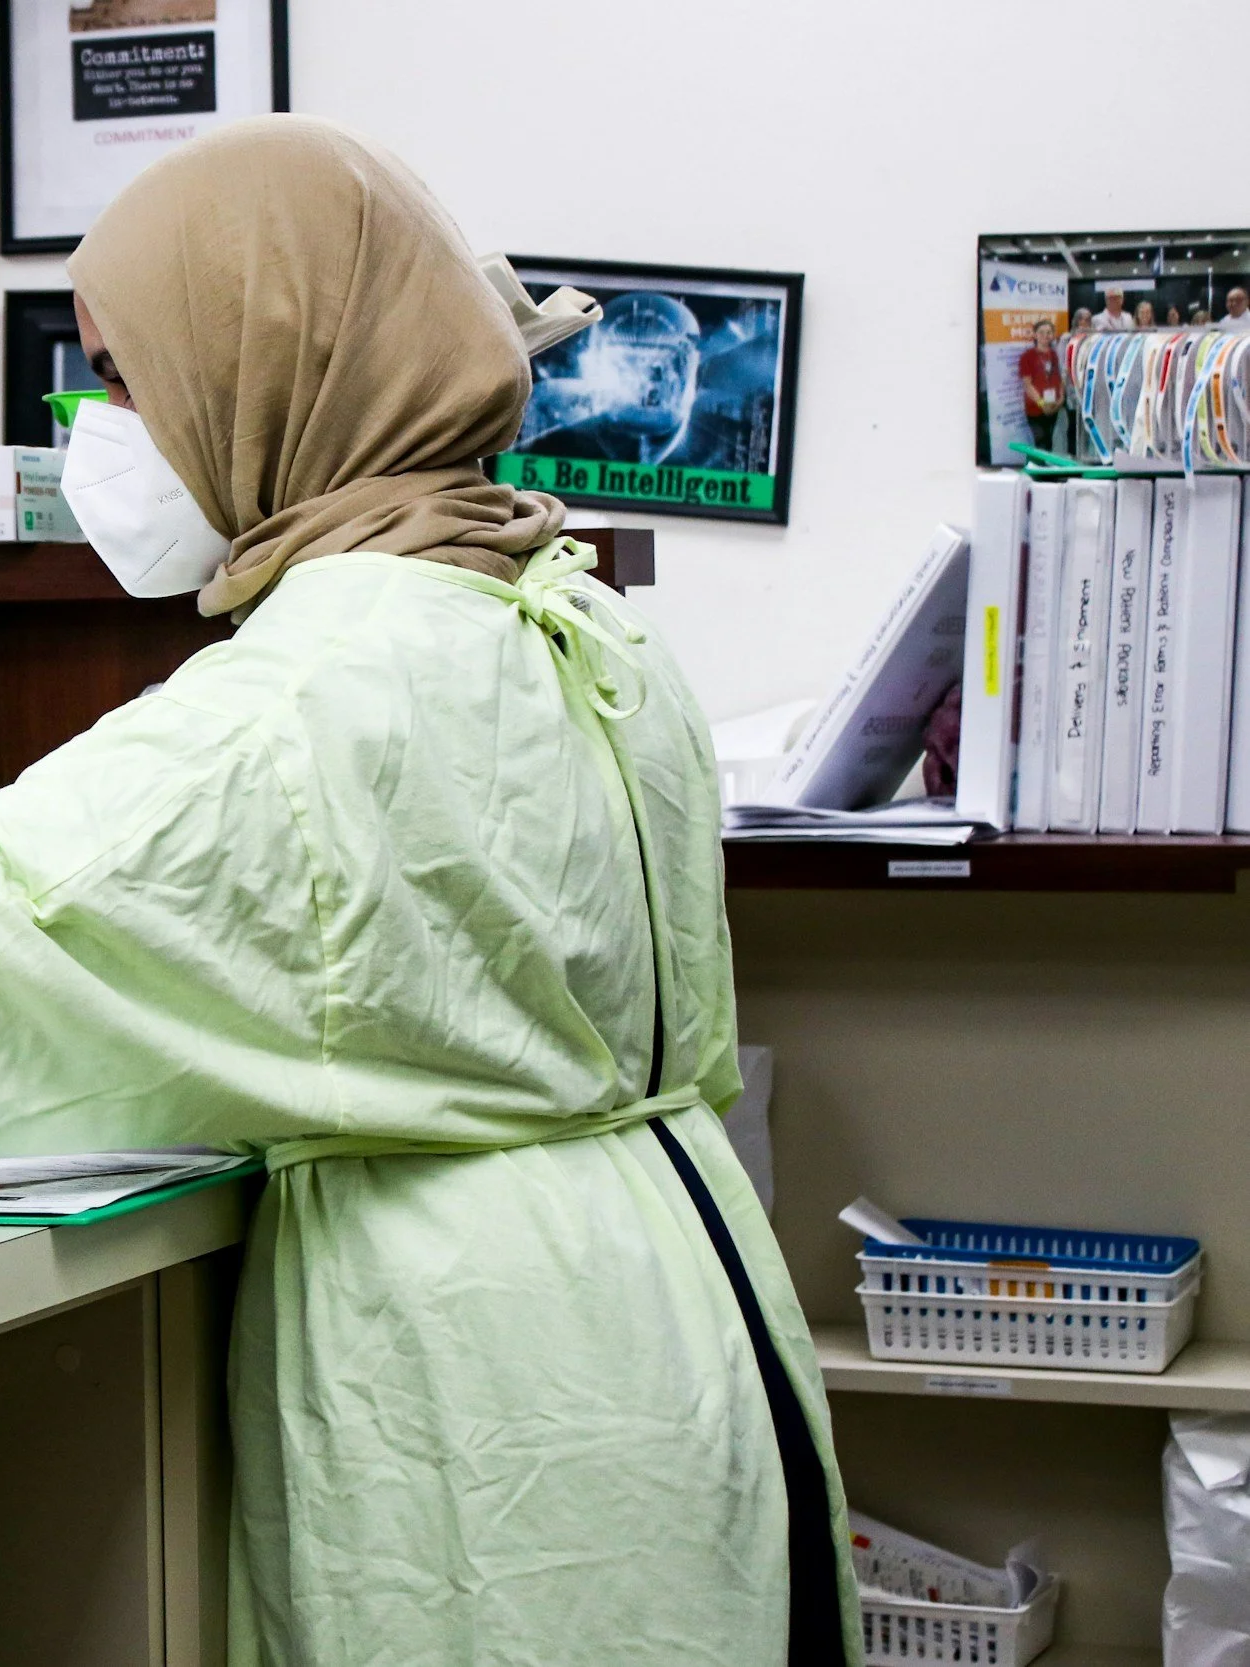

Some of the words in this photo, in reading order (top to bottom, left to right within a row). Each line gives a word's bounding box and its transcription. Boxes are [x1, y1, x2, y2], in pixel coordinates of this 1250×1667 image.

[94, 126, 195, 145] COMMITMENT
[1017, 281, 1065, 296] CPESN
[157, 488, 184, 505] KN95
[521, 459, 544, 487] 5.
[555, 462, 588, 489] Be
[600, 463, 752, 504] Intelligent
[1160, 492, 1174, 565] Complaints
[1122, 549, 1135, 580] New
[1074, 578, 1092, 653] Shipment
[1158, 573, 1169, 617] Patient
[1116, 643, 1132, 708] Packages
[1154, 636, 1168, 673] Forms
[1067, 682, 1087, 739] Delivery
[1152, 681, 1165, 713] Error
[1148, 719, 1165, 777] Reporting
